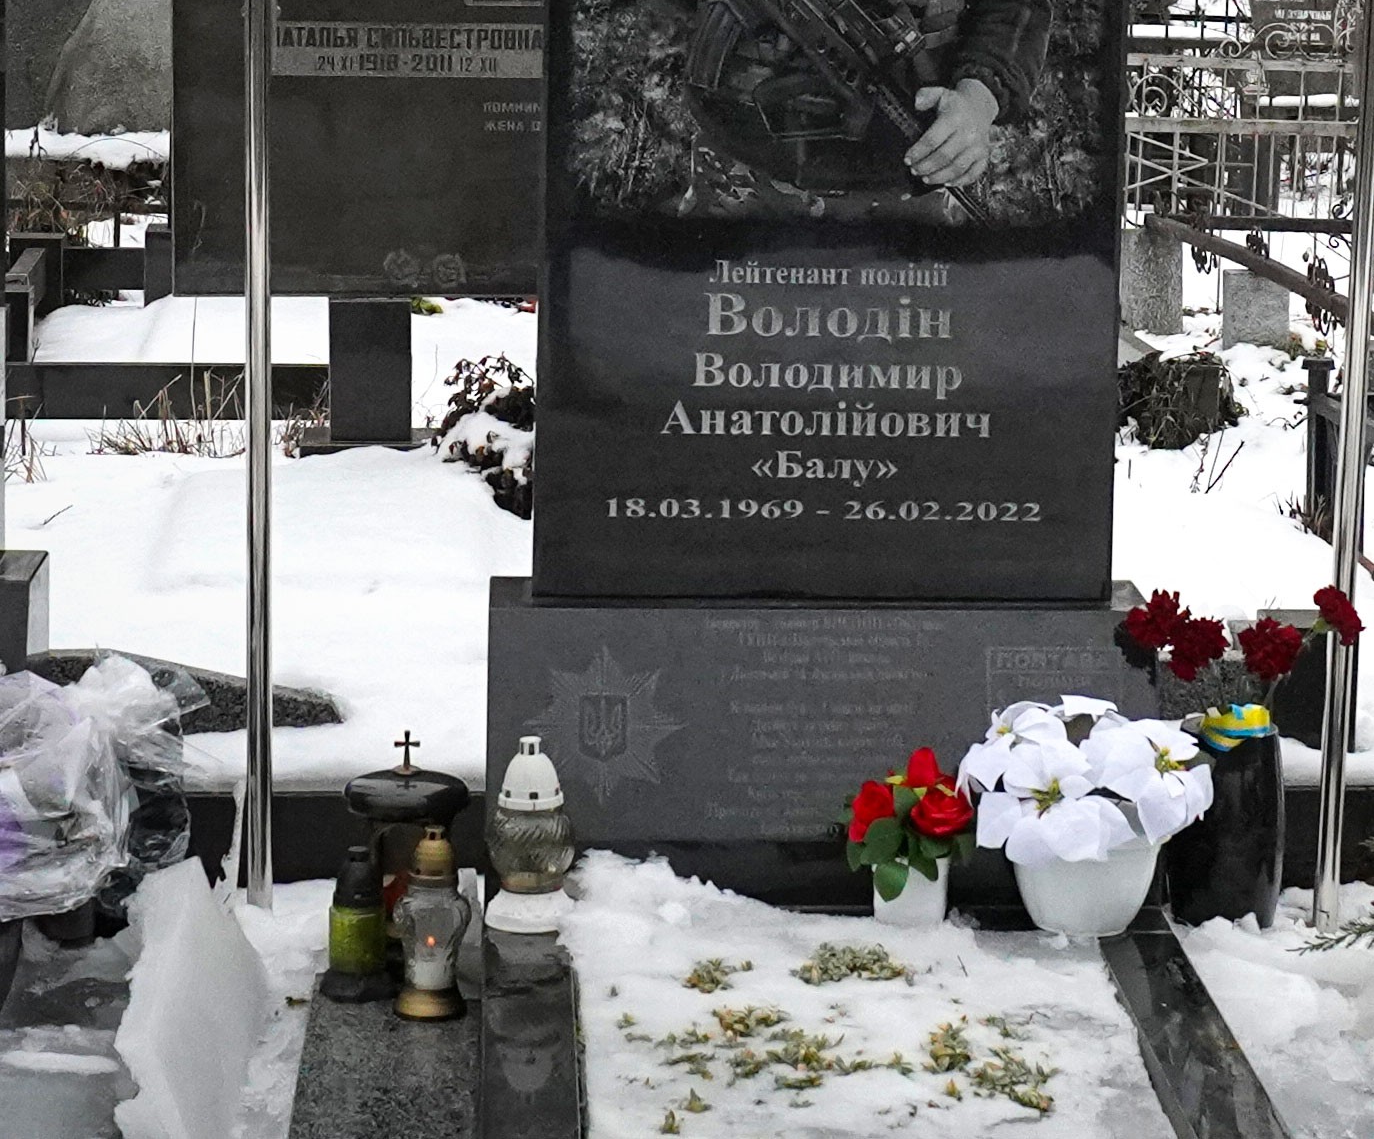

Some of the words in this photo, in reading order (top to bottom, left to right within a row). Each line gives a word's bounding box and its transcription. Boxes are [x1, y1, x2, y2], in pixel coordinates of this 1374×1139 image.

[366, 28, 544, 50] СИЛЬВЕСТРОВНА
[484, 121, 524, 132] ЖЕНА
[709, 259, 850, 284] Лейтенант
[861, 263, 950, 287] поліції
[704, 292, 951, 343] Володін
[692, 352, 963, 400] Володимир
[660, 400, 992, 438] Анатолійович
[751, 450, 898, 487] «Балу»
[605, 498, 804, 519] 18.03.1969
[843, 500, 1042, 522] 26.02.2022
